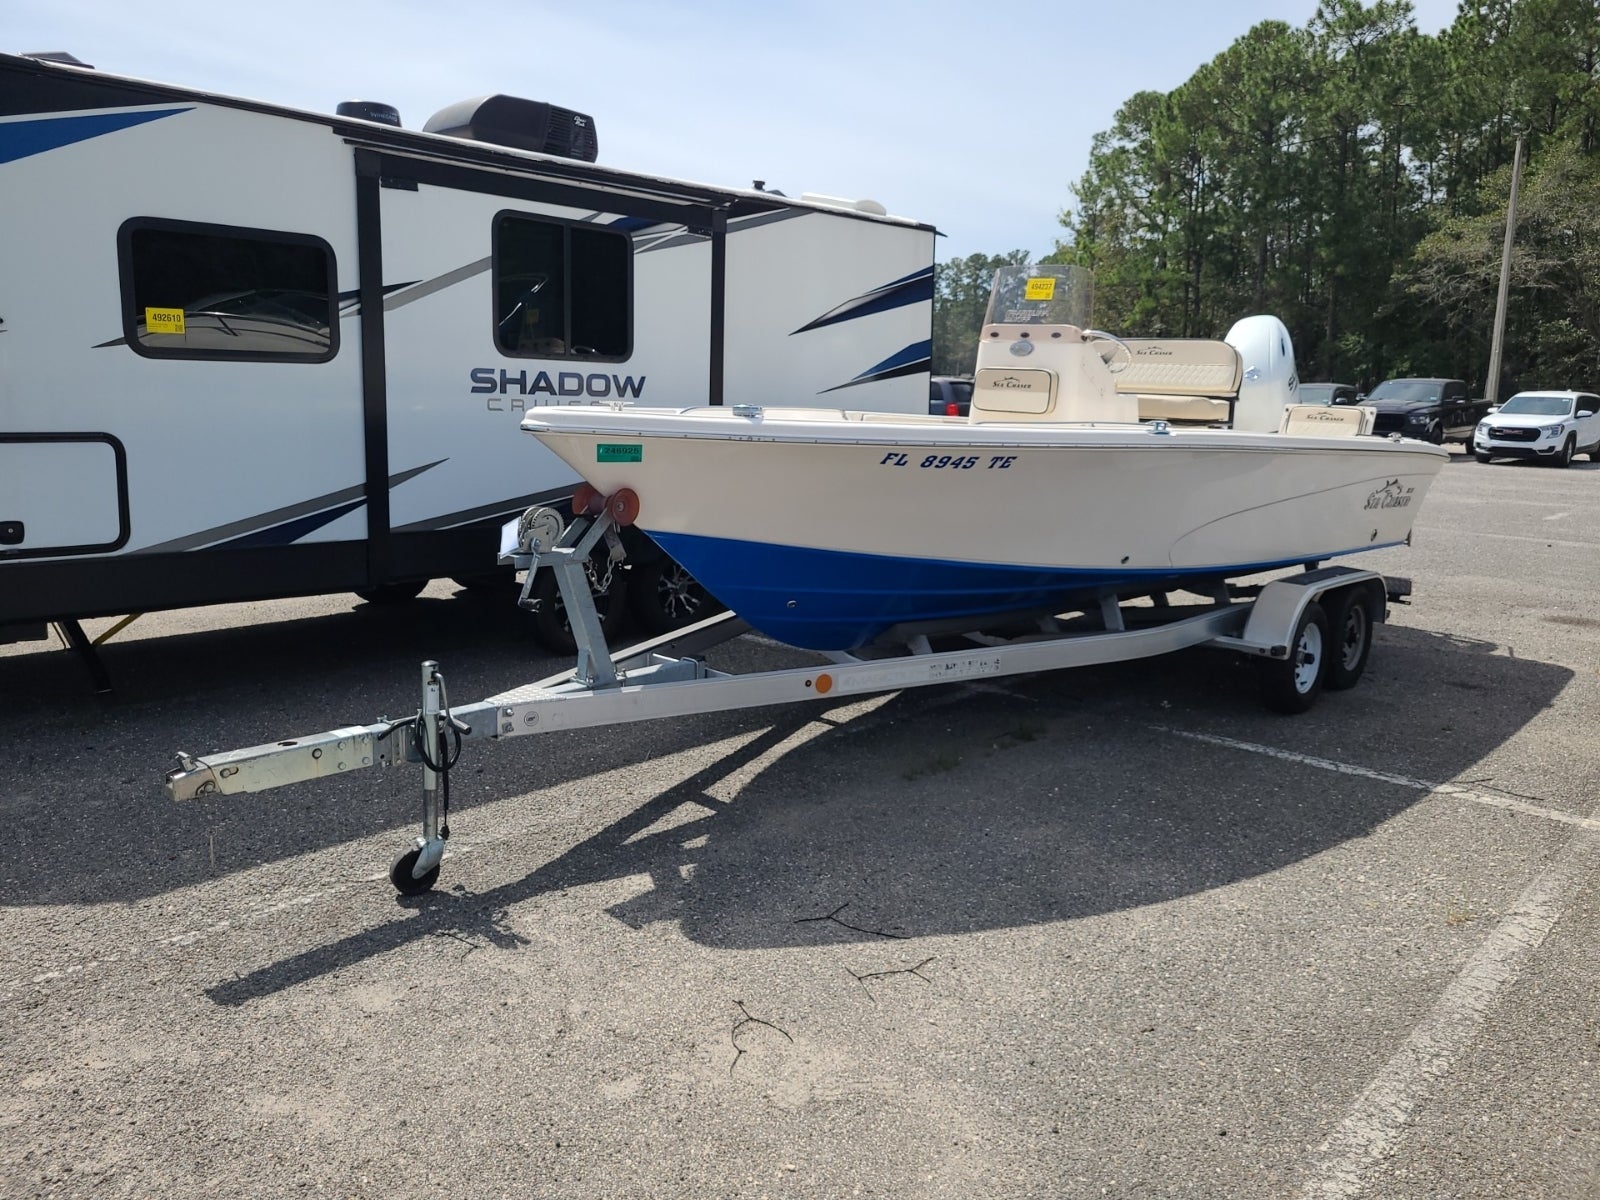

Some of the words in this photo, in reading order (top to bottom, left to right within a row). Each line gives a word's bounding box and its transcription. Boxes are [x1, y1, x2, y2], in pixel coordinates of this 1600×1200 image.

[152, 313, 181, 322] 492610
[470, 367, 646, 398] SHADOW
[880, 452, 908, 467] FL
[920, 455, 980, 469] 8945
[988, 456, 1018, 469] TE
